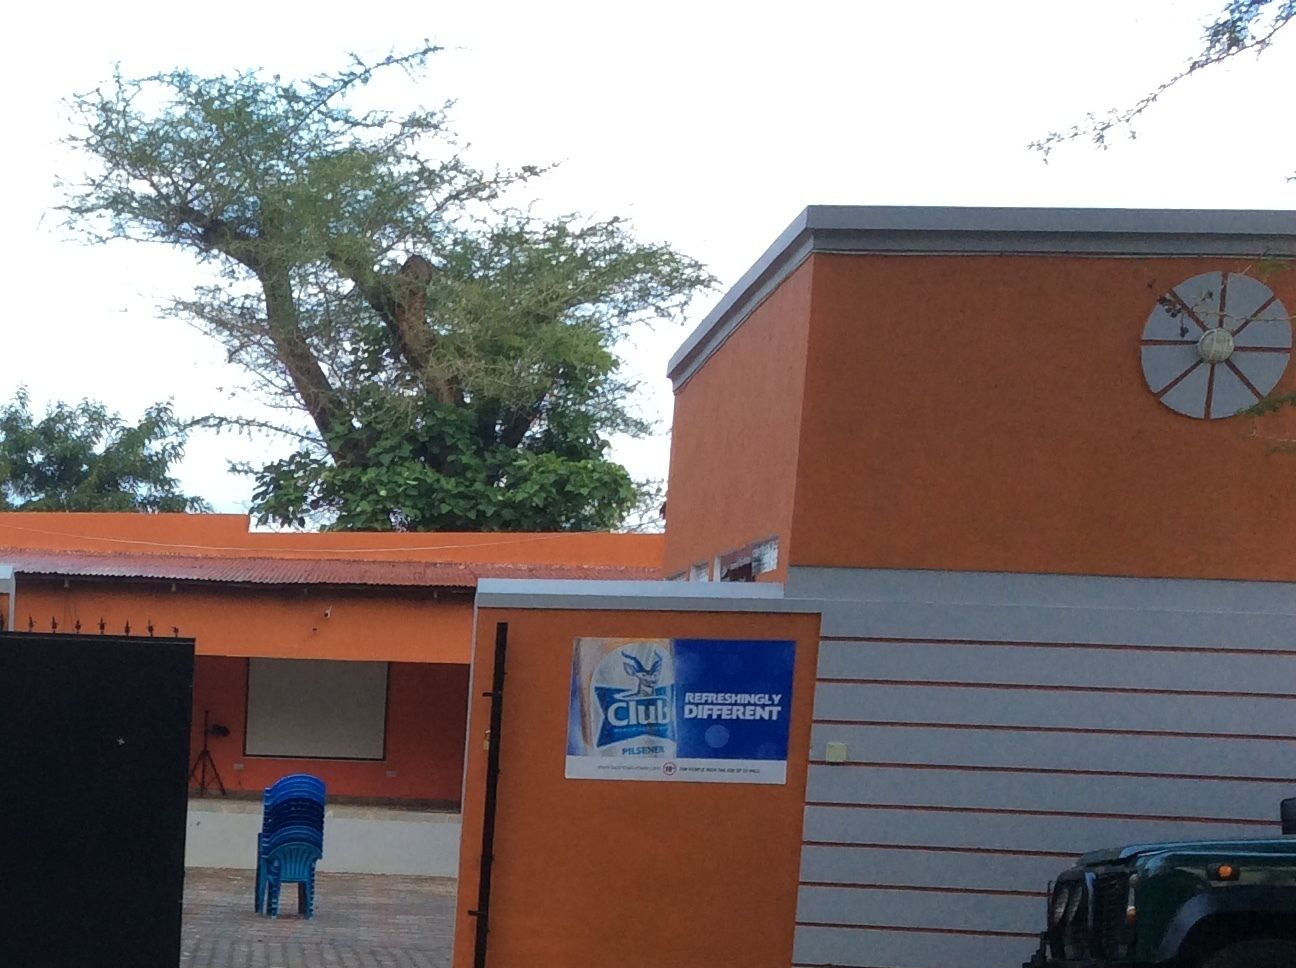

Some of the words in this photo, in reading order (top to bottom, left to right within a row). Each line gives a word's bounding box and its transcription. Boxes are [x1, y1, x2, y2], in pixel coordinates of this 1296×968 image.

[684, 692, 782, 705] REFRESHINGLY
[607, 700, 671, 727] Club
[684, 704, 782, 721] DIFFERENT
